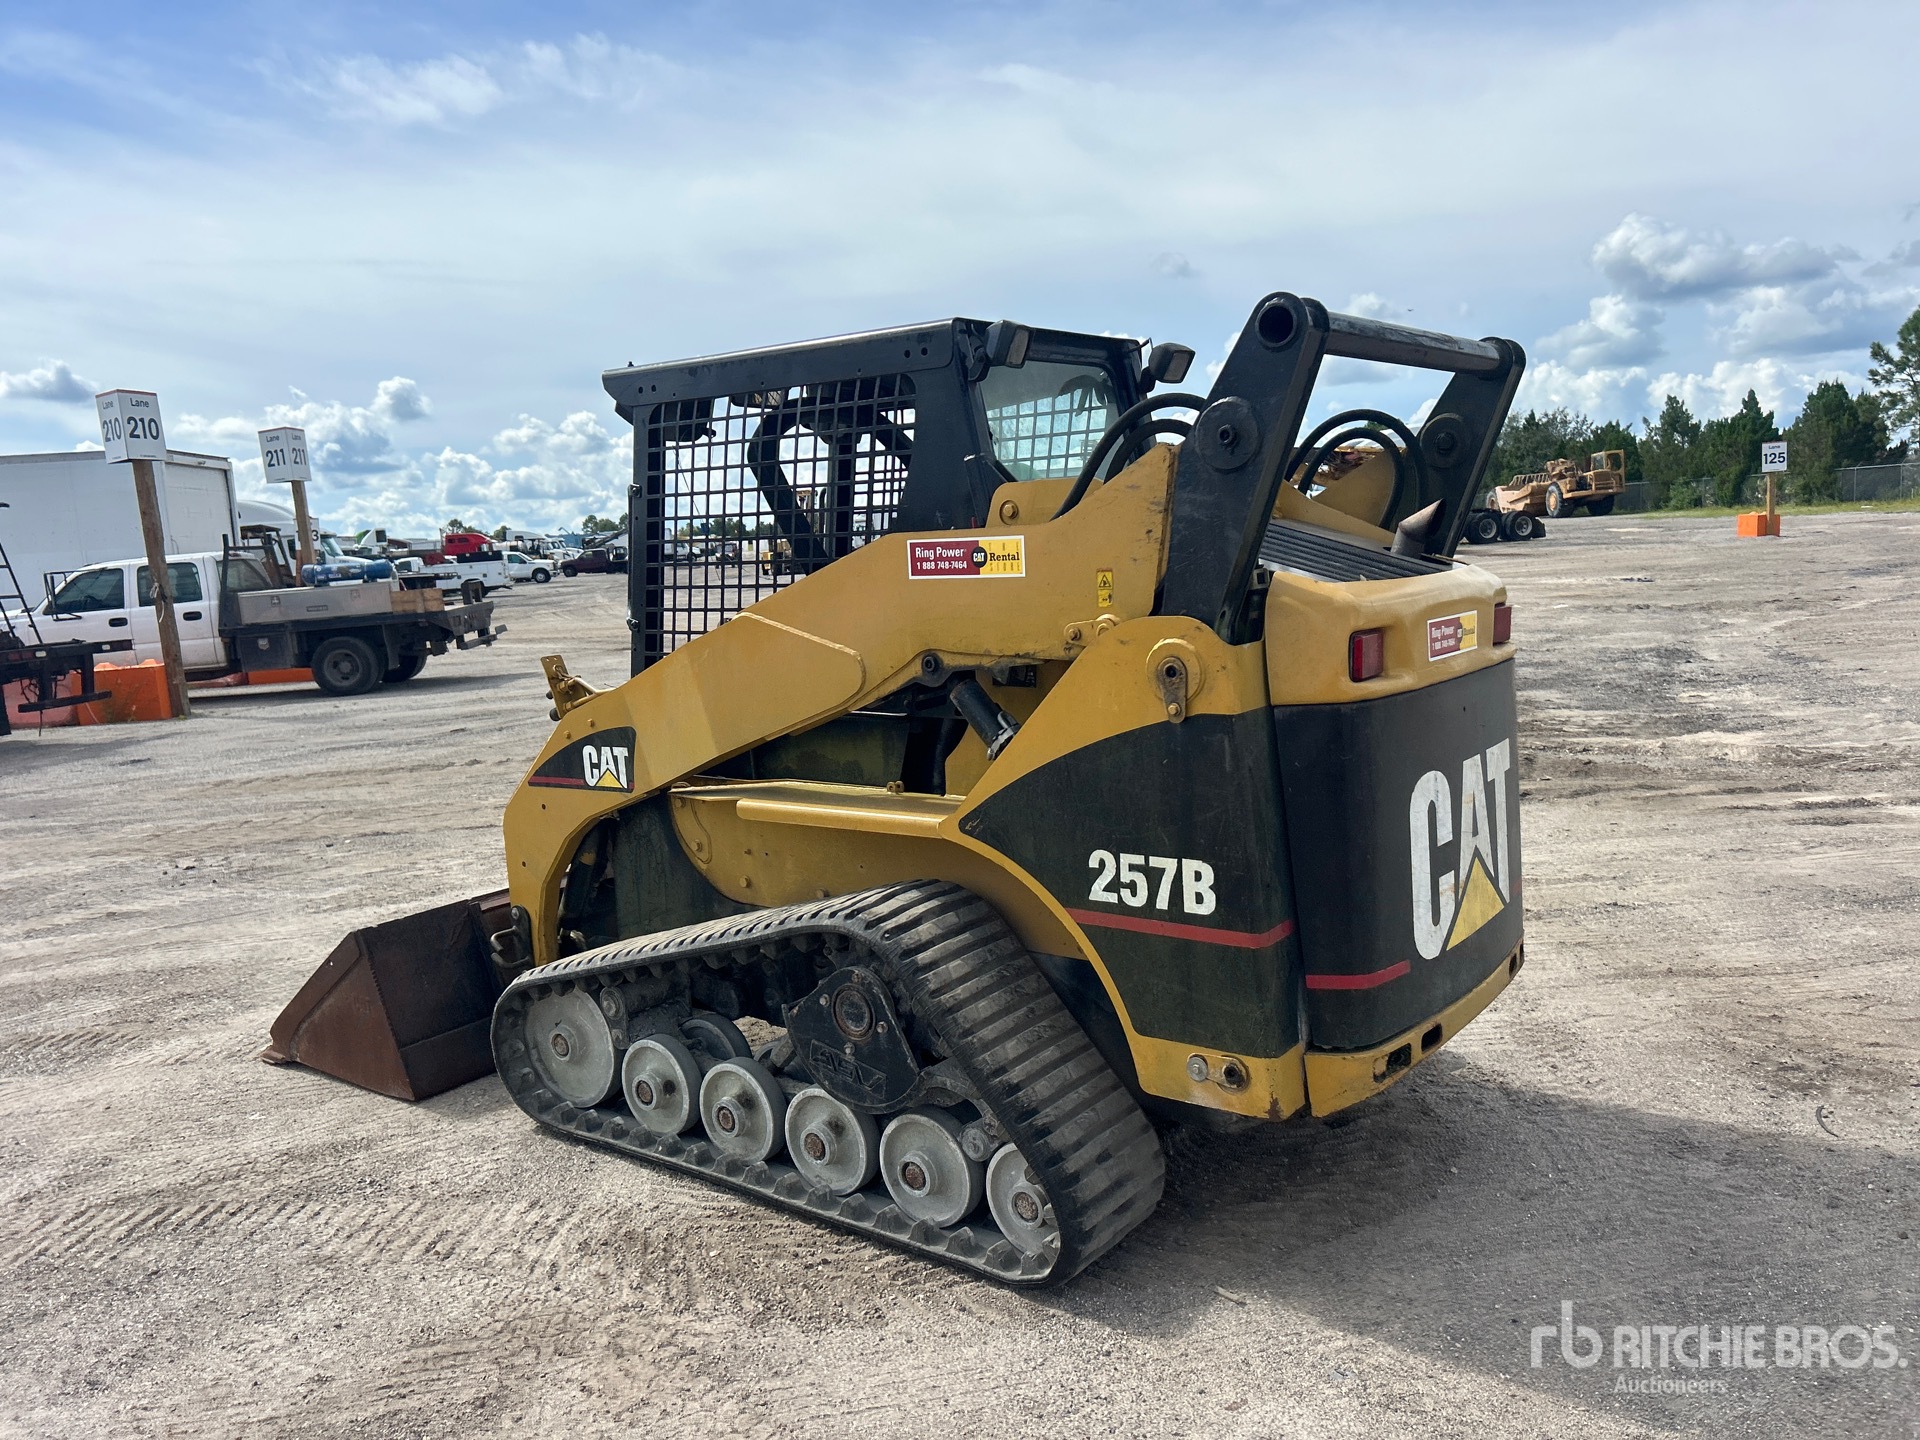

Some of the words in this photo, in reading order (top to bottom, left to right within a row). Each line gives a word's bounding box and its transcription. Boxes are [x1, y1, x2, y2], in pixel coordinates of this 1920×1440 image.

[129, 397, 150, 408] Lane
[102, 417, 122, 443] 210
[126, 415, 160, 441] 210
[265, 435, 280, 443] Lane
[265, 448, 286, 468] 211
[291, 447, 307, 466] 211
[1763, 452, 1786, 464] 125
[915, 547, 934, 560] Ring
[936, 546, 965, 558] Power
[973, 552, 984, 562] CAT
[988, 551, 1020, 562] Rental
[916, 562, 920, 570] 1
[922, 561, 936, 570] 888
[936, 560, 968, 570] 748-7464
[582, 744, 629, 789] CAT
[1410, 737, 1511, 960] CAT
[1088, 849, 1217, 916] 257B
